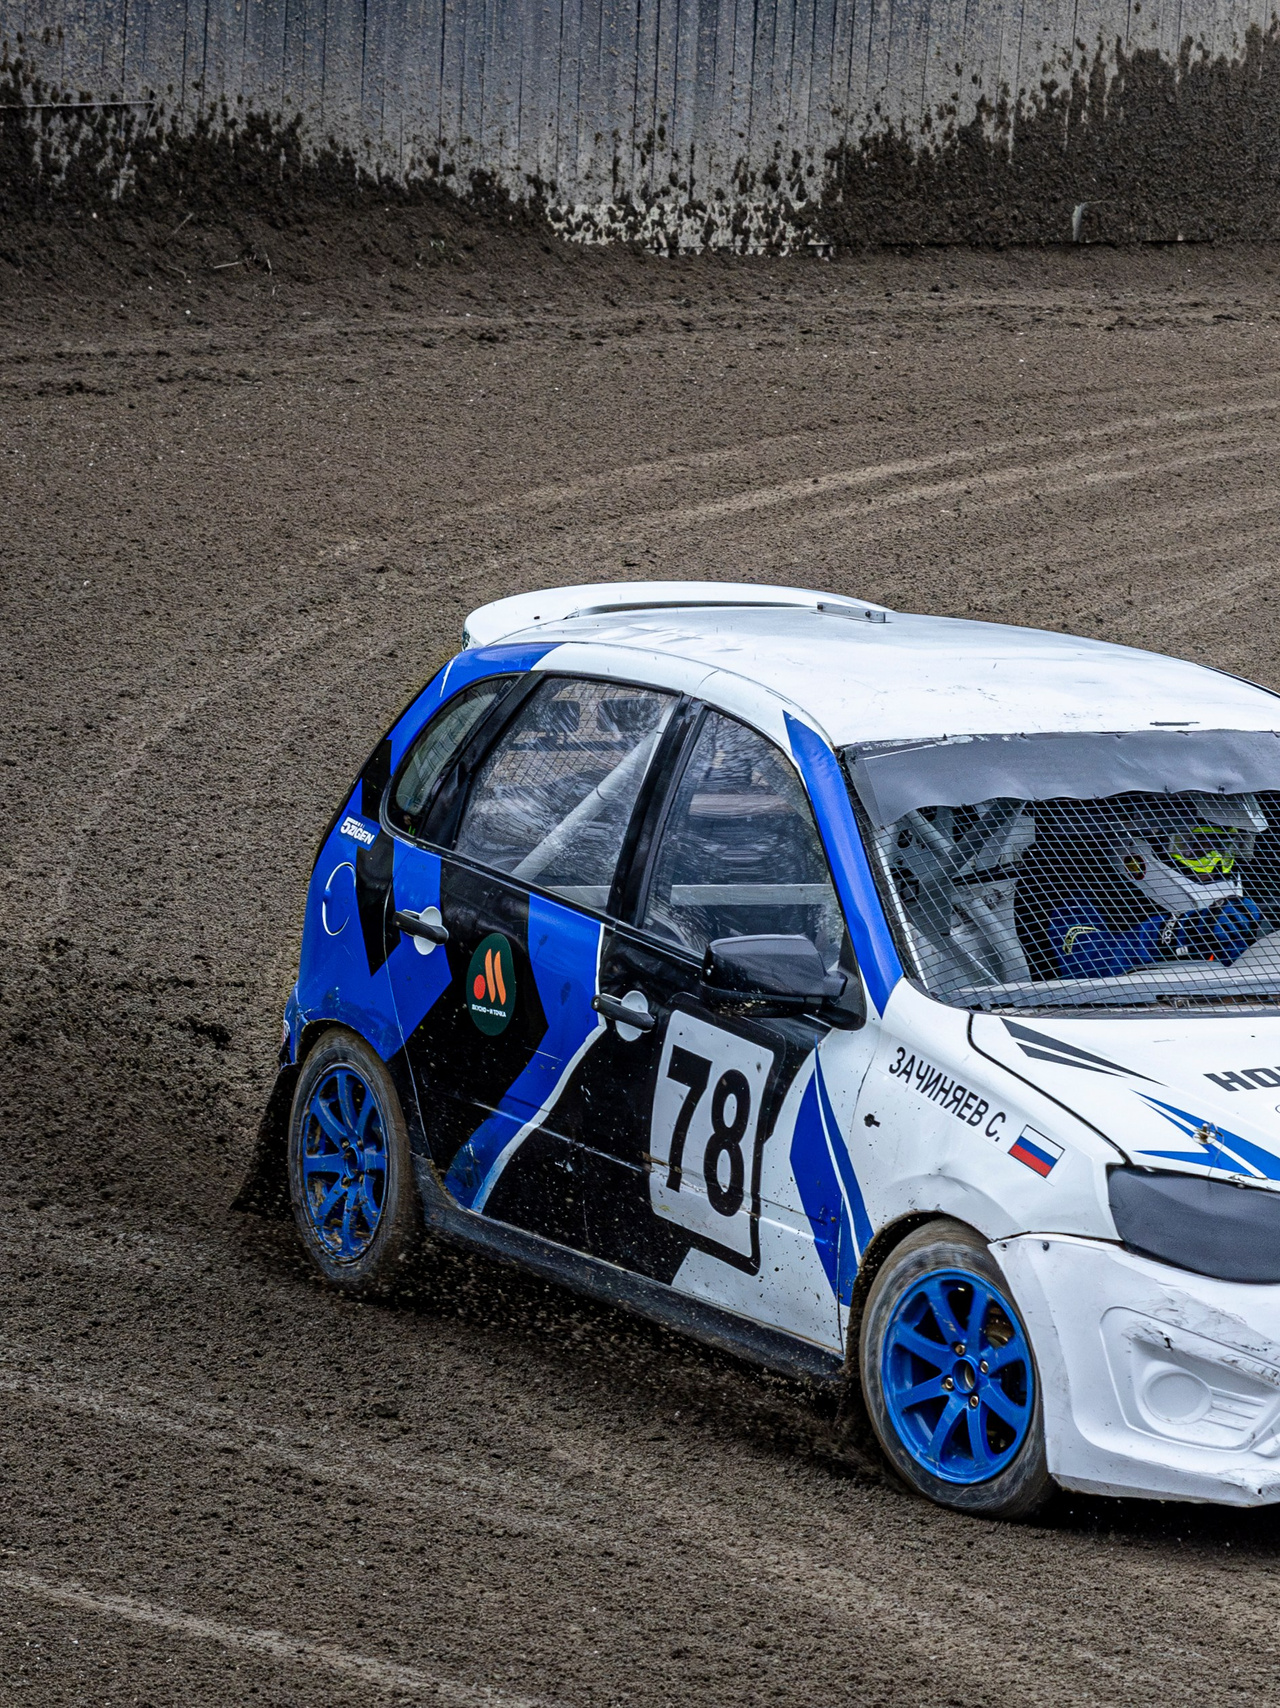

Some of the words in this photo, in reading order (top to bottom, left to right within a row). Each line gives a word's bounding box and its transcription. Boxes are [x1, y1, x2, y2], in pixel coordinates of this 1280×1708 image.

[340, 816, 375, 845] 5ZIGEN
[666, 1044, 751, 1217] 78
[888, 1046, 990, 1127] ЗАЧИНЯЕВ
[984, 1111, 1007, 1143] С.
